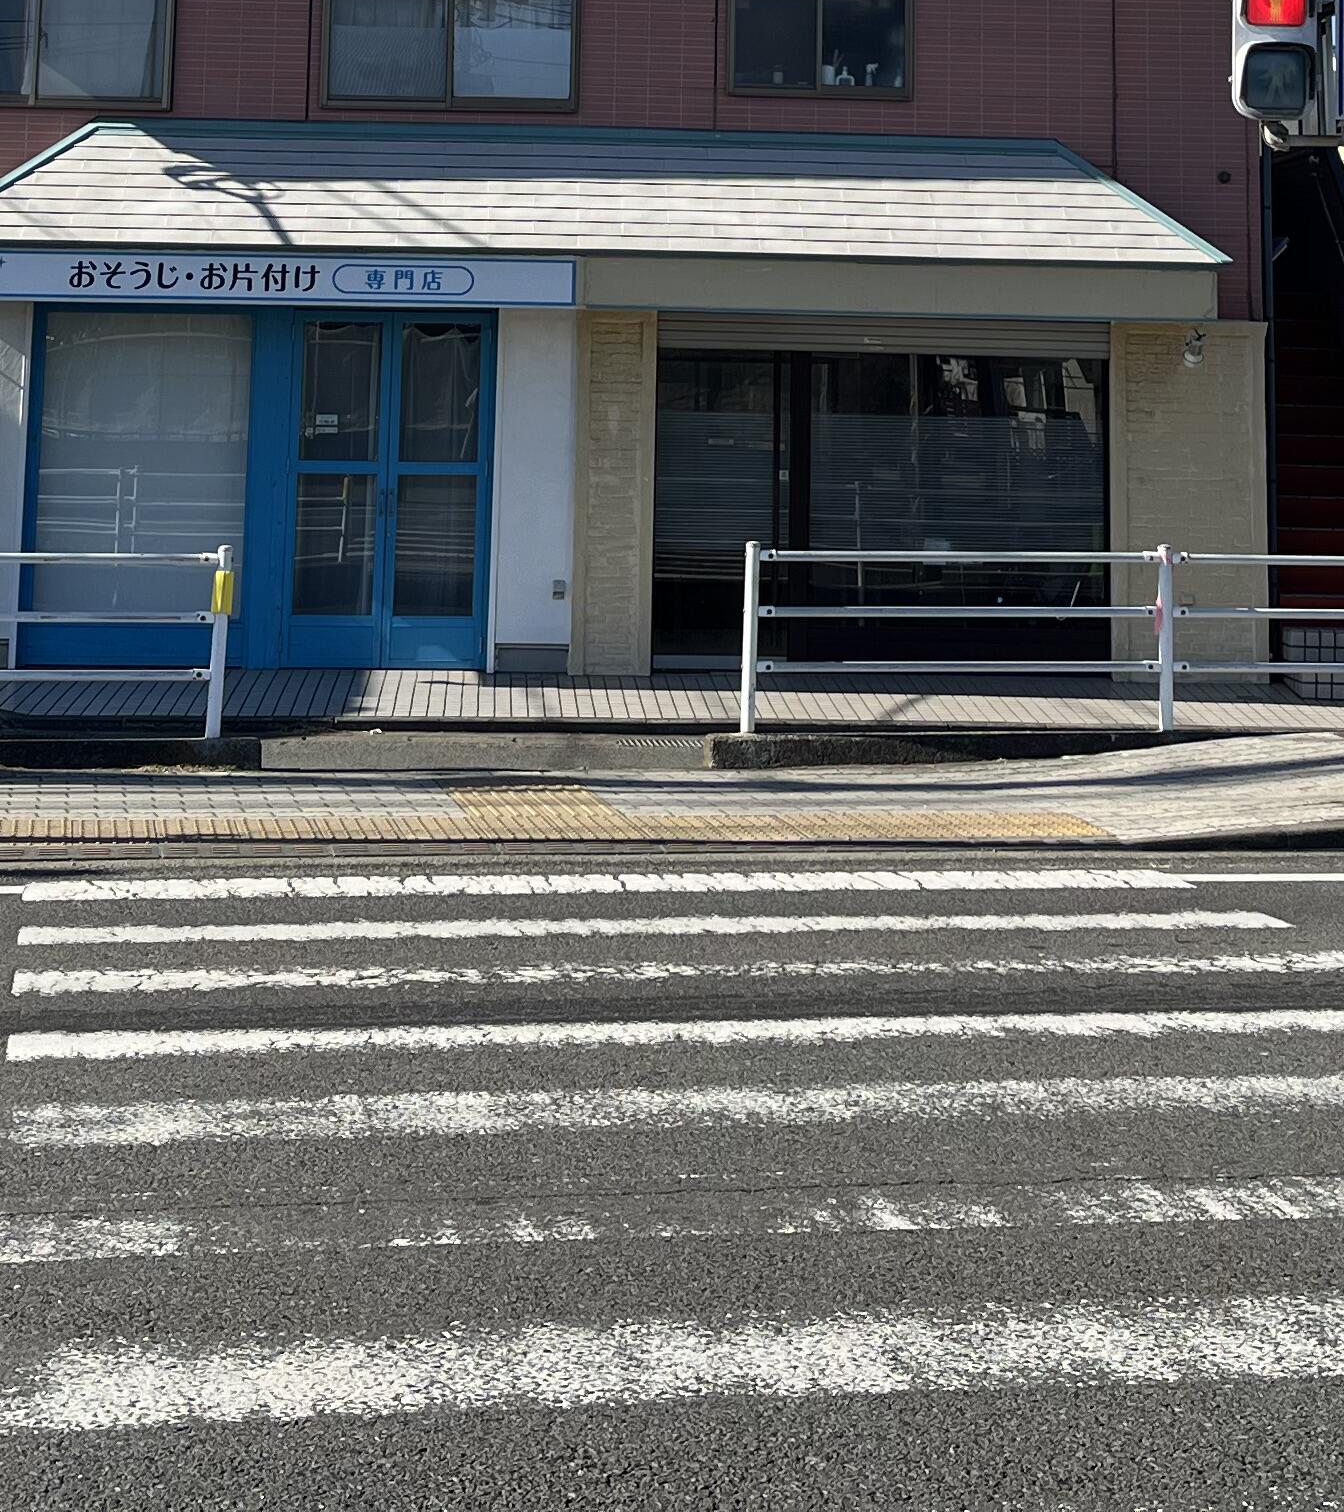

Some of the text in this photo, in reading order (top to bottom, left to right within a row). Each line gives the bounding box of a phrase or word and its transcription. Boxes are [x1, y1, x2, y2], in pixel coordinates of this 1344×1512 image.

[68, 260, 444, 292] おそうじ・お片付け 専門店
